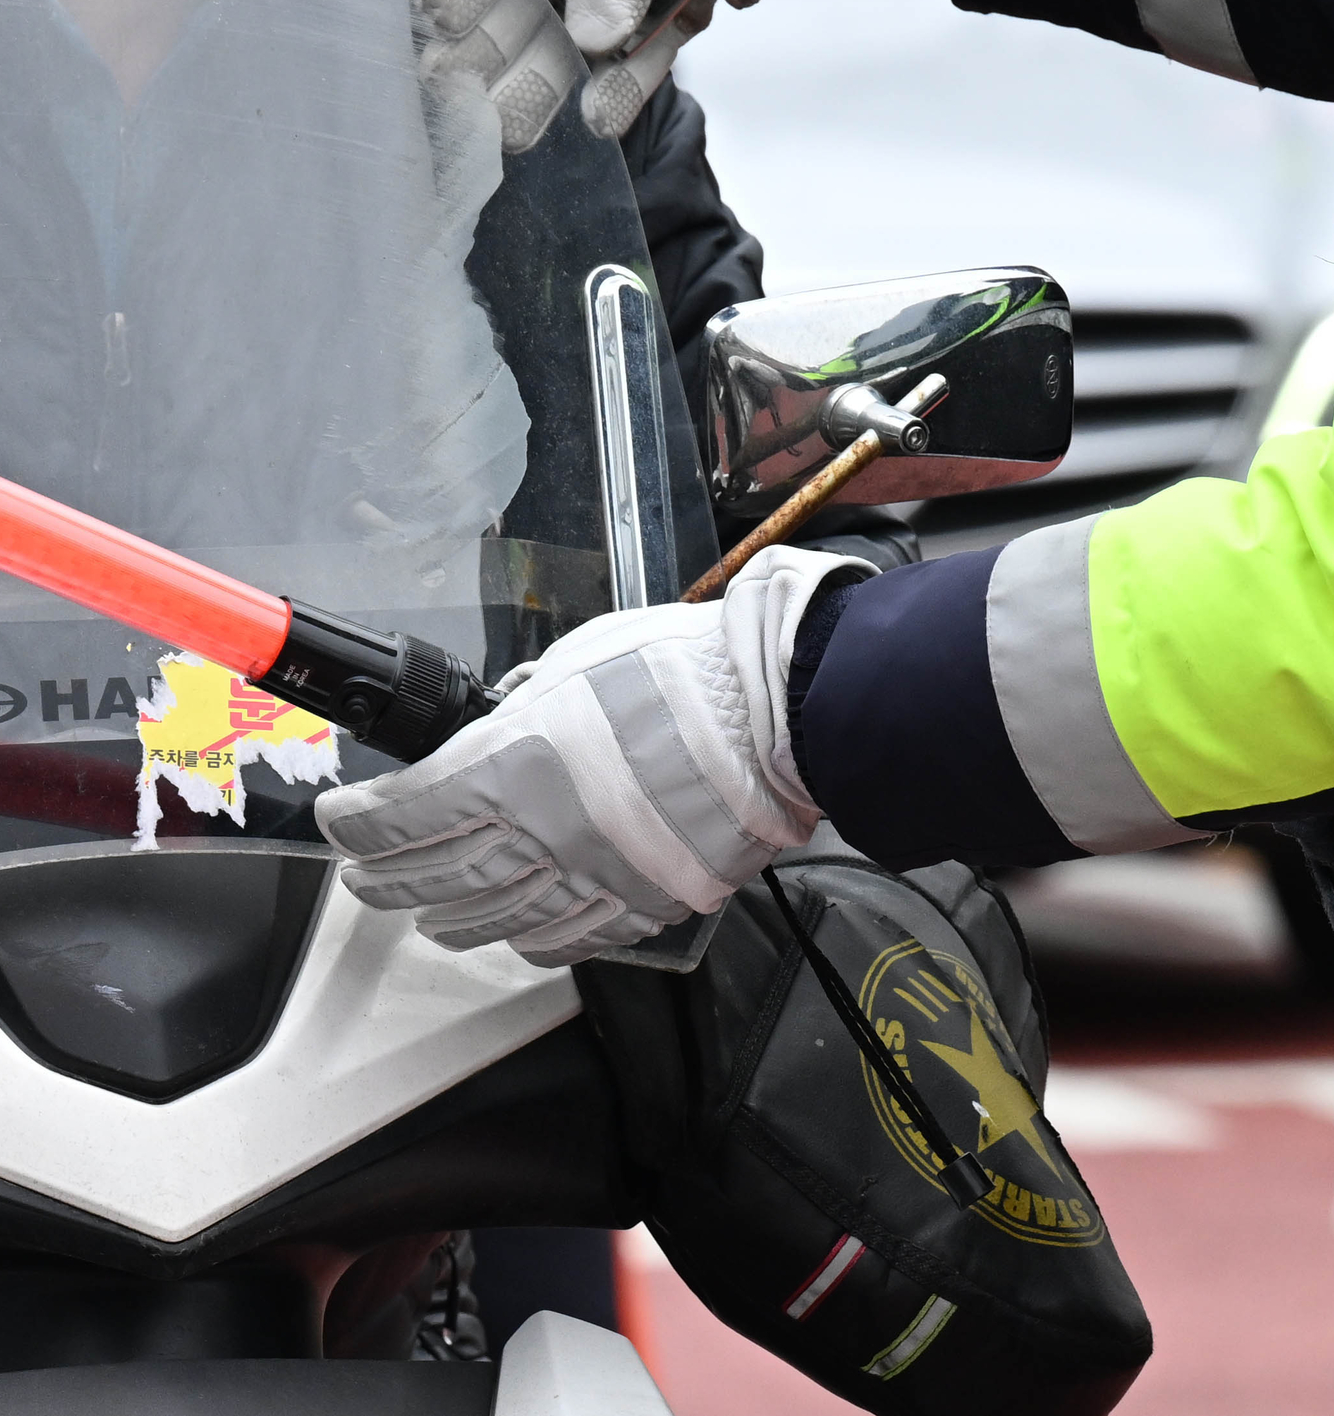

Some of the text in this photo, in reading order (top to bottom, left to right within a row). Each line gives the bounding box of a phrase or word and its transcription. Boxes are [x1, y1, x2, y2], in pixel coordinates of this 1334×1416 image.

[283, 664, 296, 682] MADE
[292, 672, 300, 680] IN
[296, 669, 311, 688] KOREA
[40, 676, 161, 722] HA
